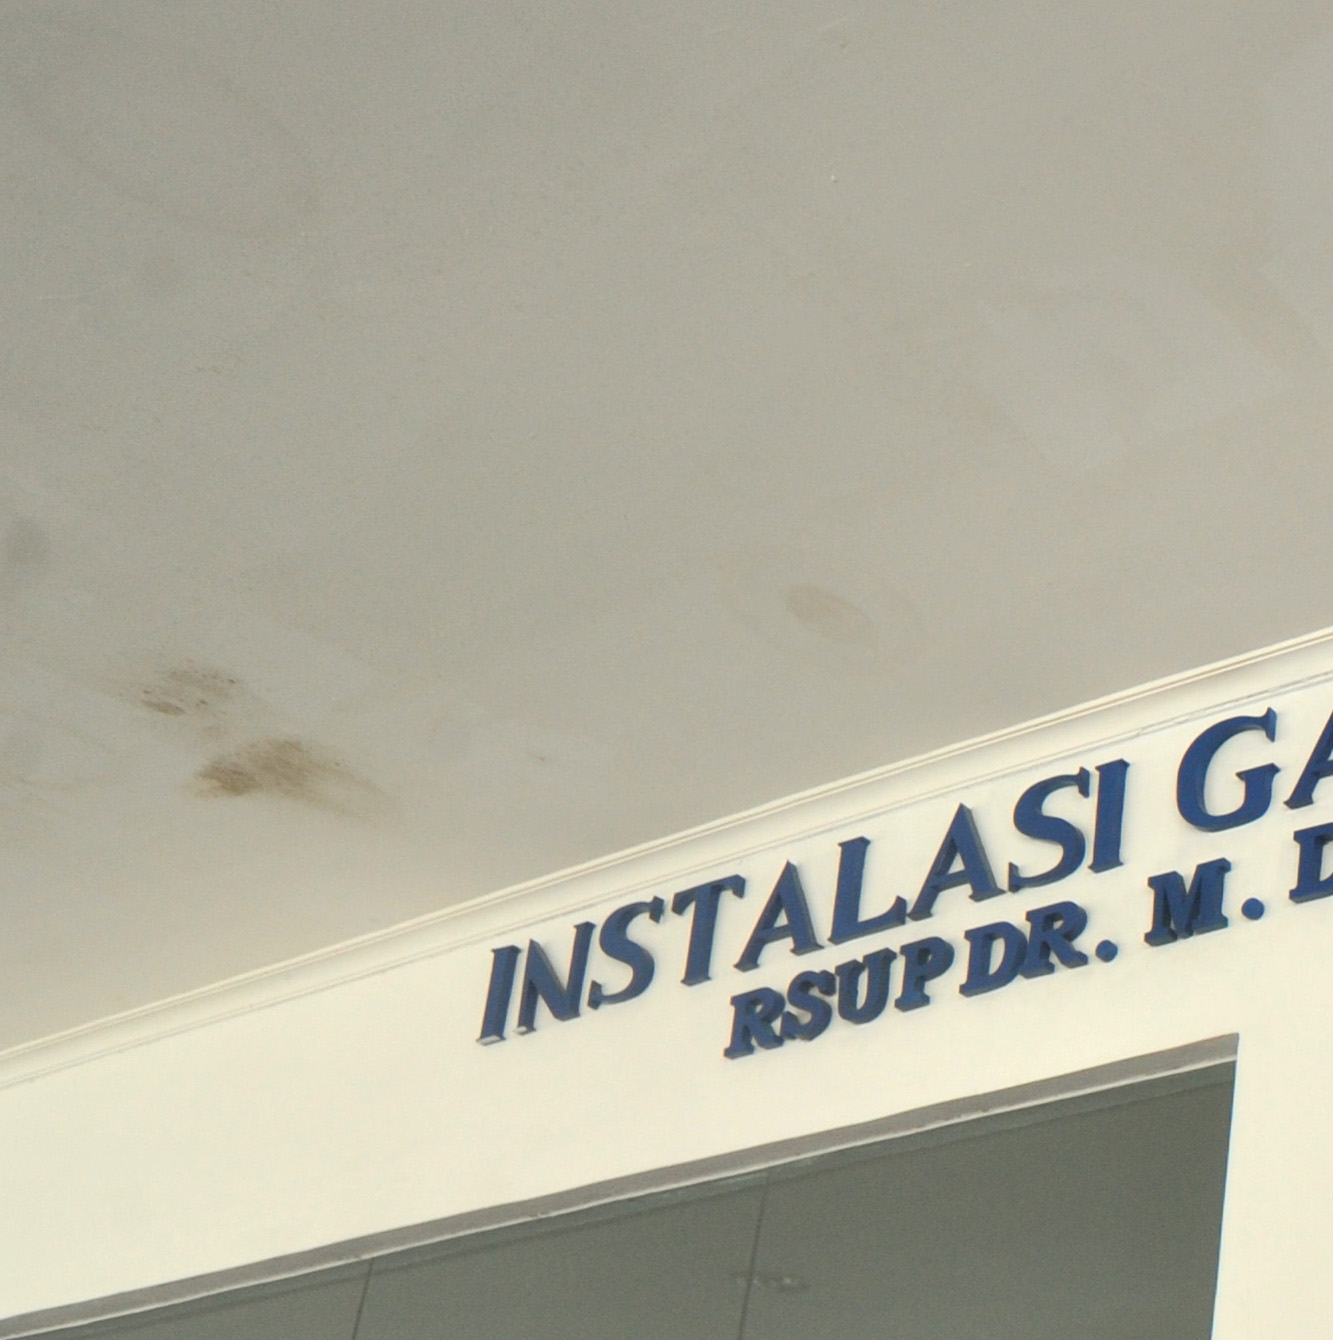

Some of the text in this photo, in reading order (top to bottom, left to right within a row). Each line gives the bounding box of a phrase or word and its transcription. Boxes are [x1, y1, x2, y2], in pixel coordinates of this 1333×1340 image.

[477, 758, 1131, 1044] INSTALASI
[723, 942, 955, 1060] RSUP
[959, 898, 1119, 998] DR.
[1143, 857, 1266, 947] M.
